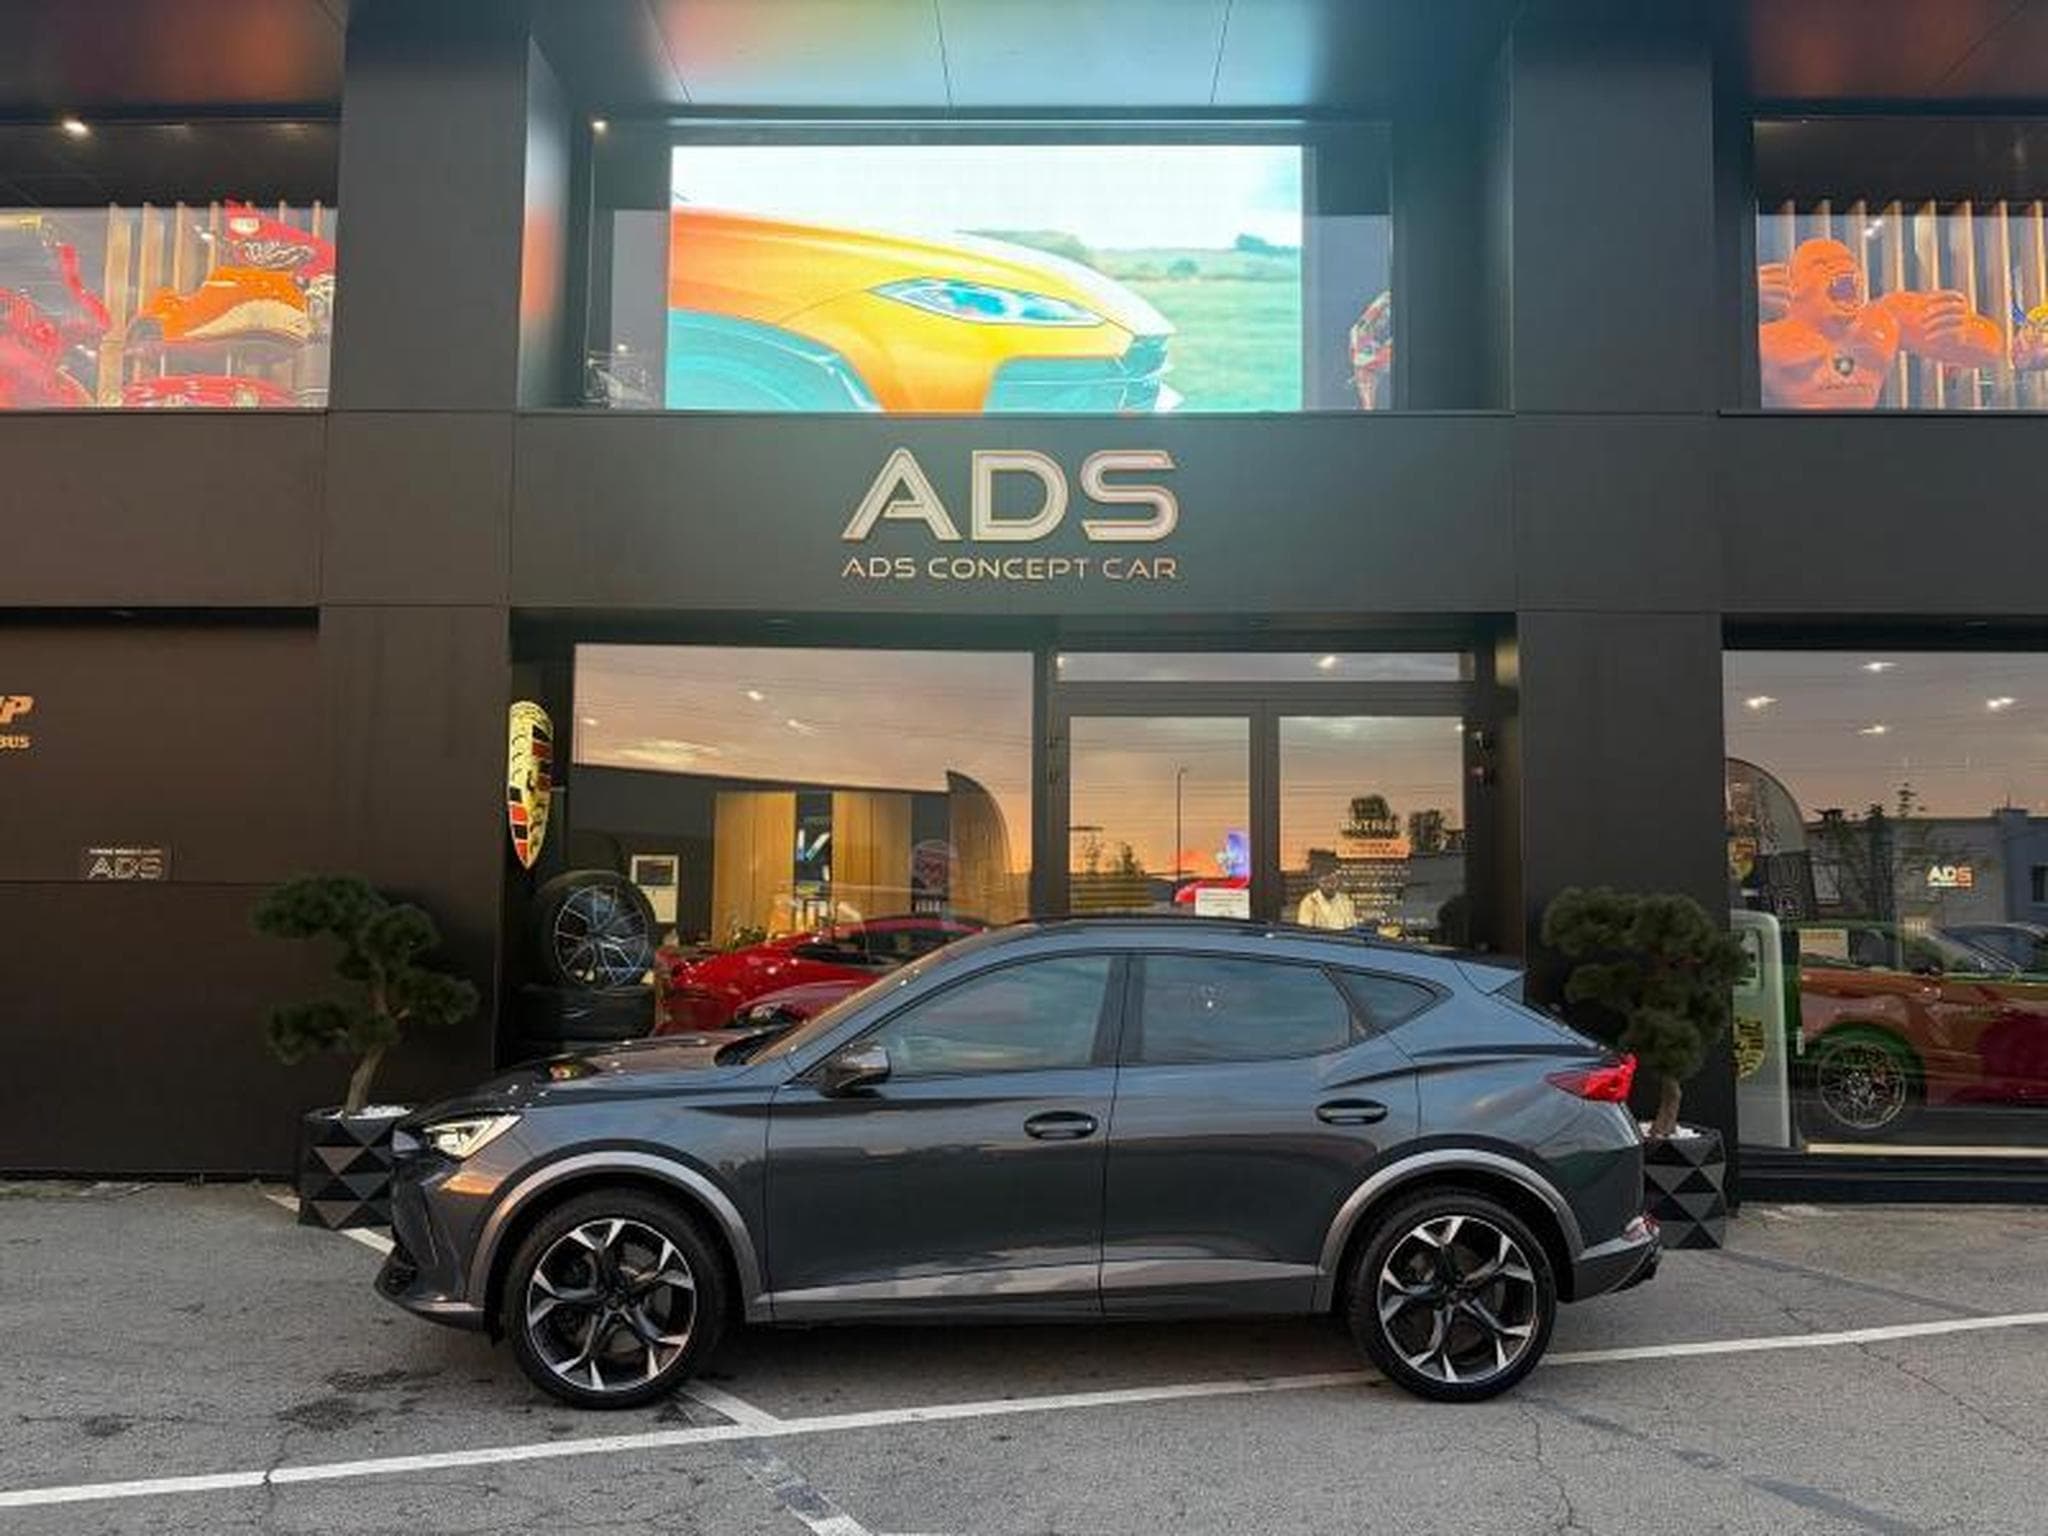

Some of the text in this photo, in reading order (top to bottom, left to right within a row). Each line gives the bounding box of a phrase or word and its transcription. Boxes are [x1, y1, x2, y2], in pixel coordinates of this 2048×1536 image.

[841, 448, 1179, 541] ADS
[841, 557, 1177, 580] ADS CONCEPT CAR
[87, 857, 162, 879] ADS
[1927, 865, 1972, 882] ADS
